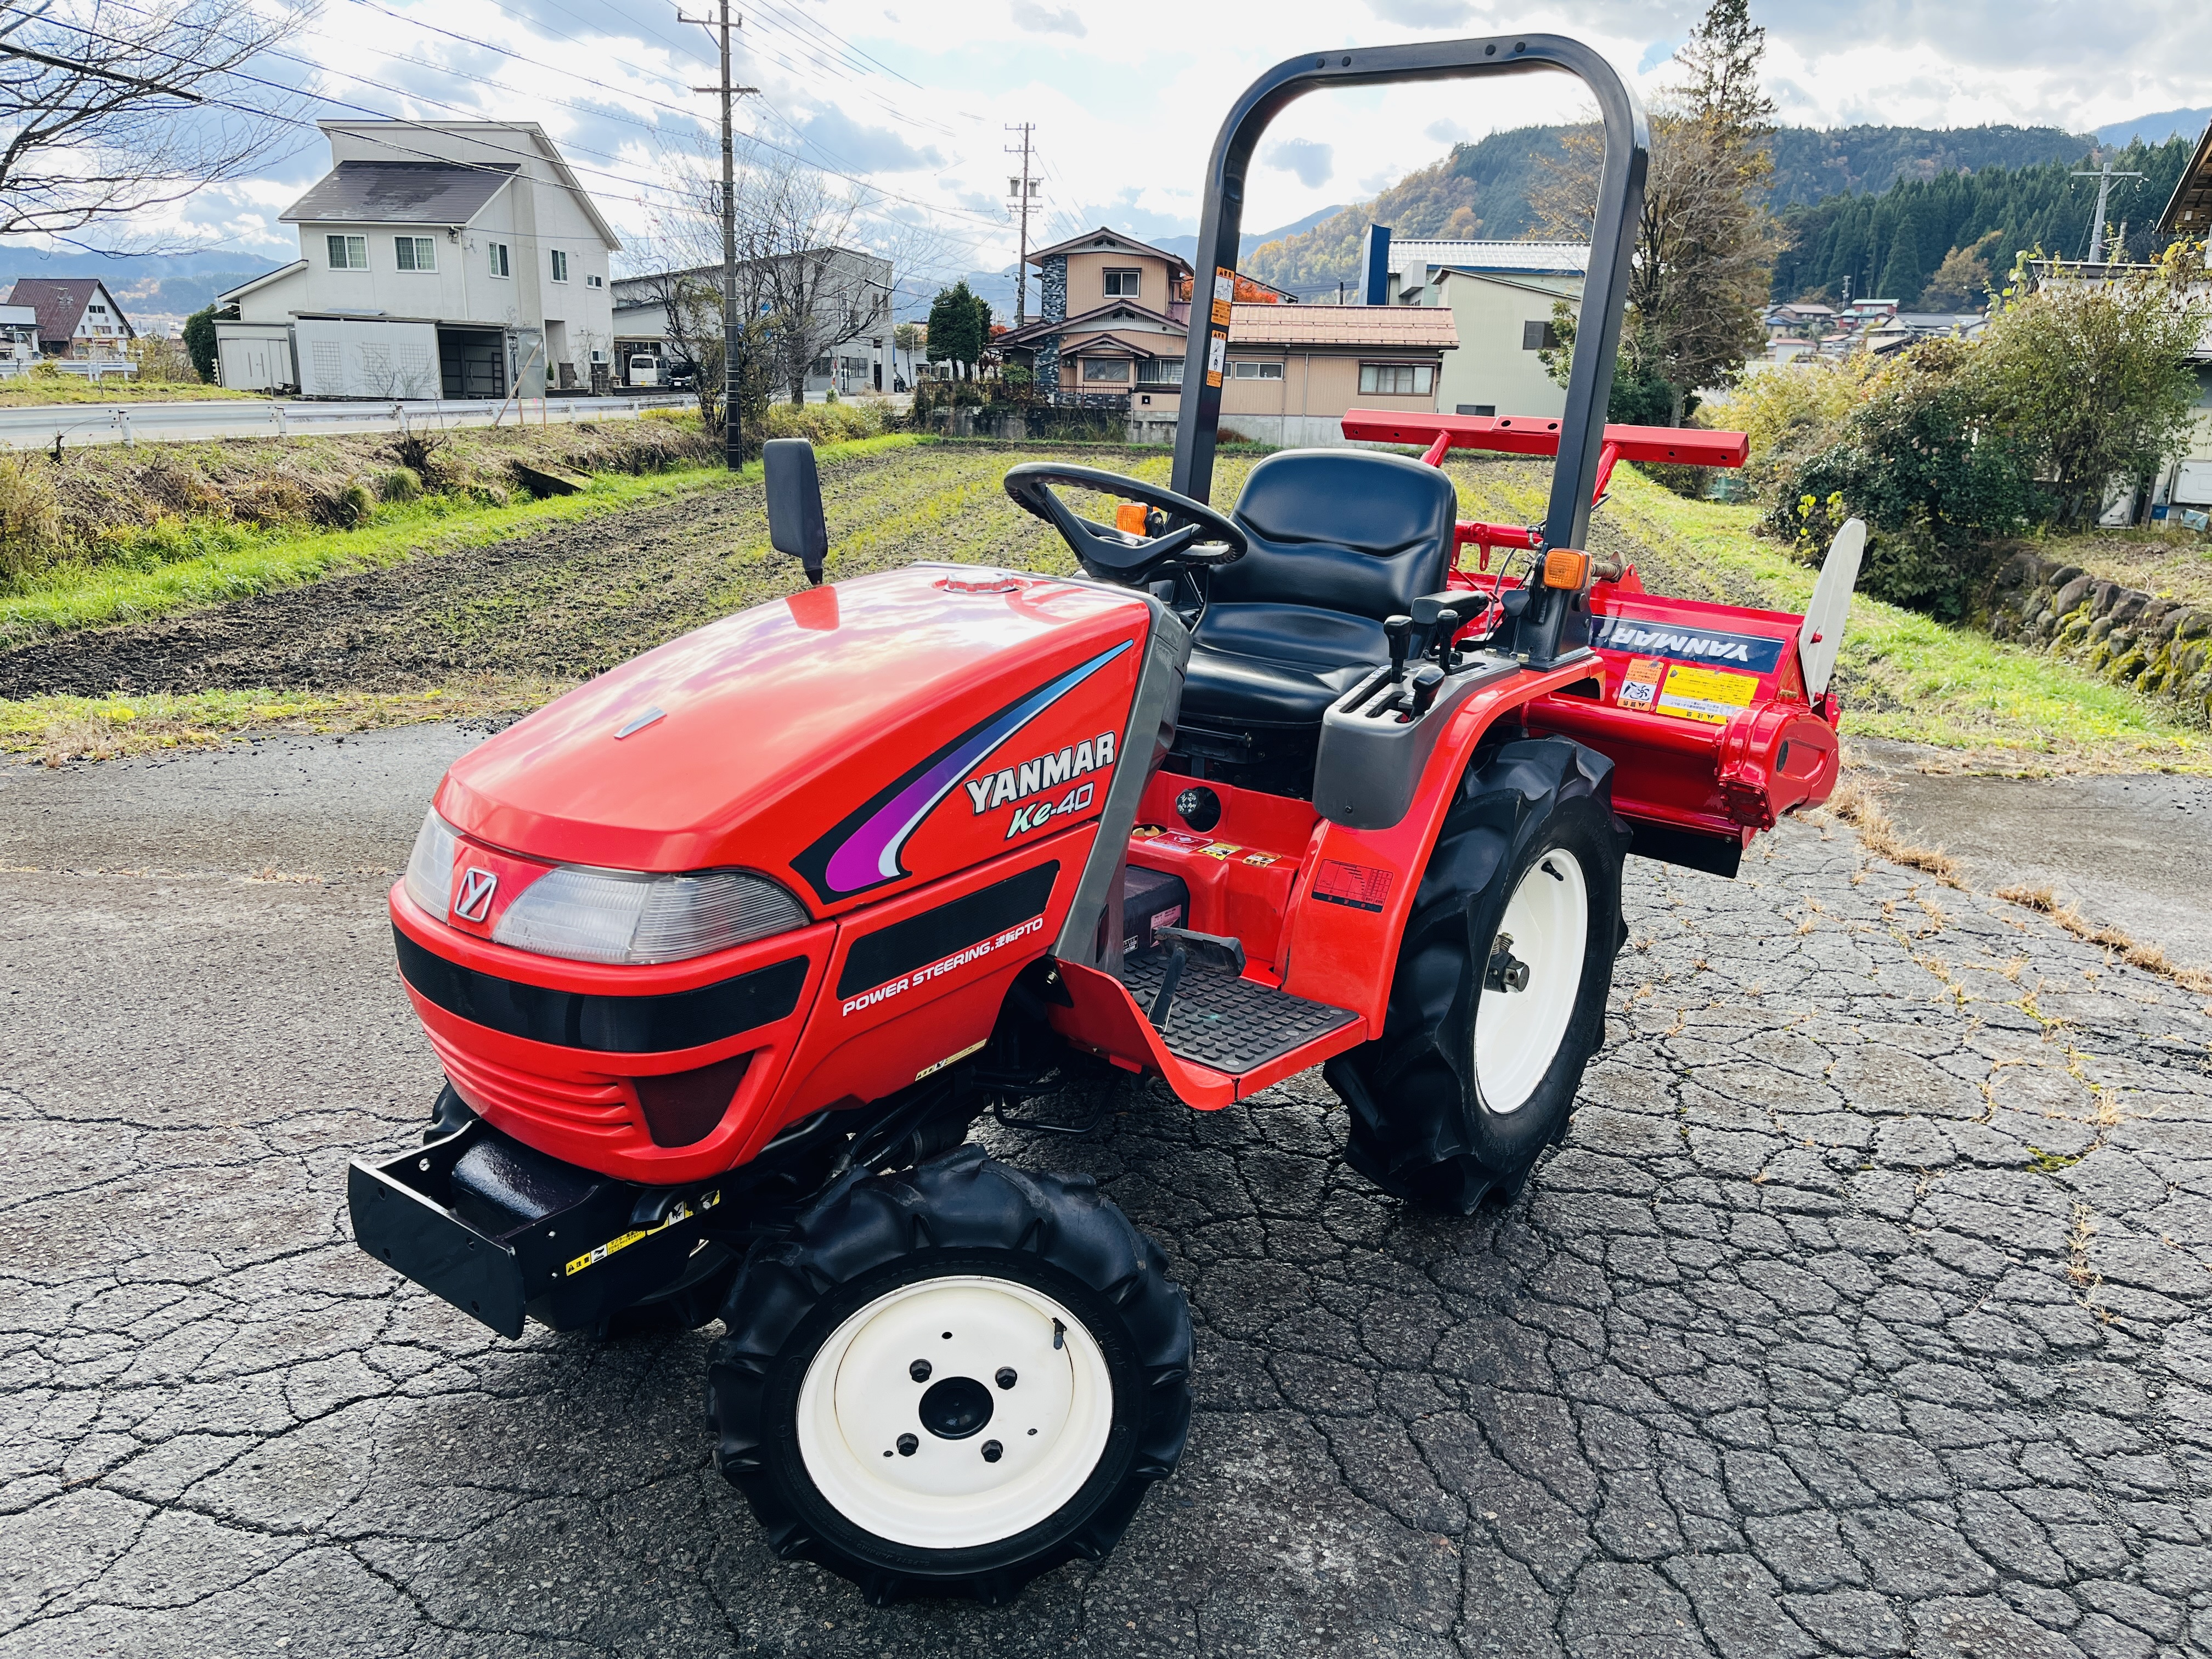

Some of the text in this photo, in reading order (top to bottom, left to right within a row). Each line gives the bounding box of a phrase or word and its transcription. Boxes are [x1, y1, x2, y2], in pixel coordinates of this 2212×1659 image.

[1611, 628, 1748, 662] YANMAR
[964, 731, 1115, 815] YANMAR
[1005, 782, 1094, 840] Ke-40
[843, 978, 909, 1017] POWER
